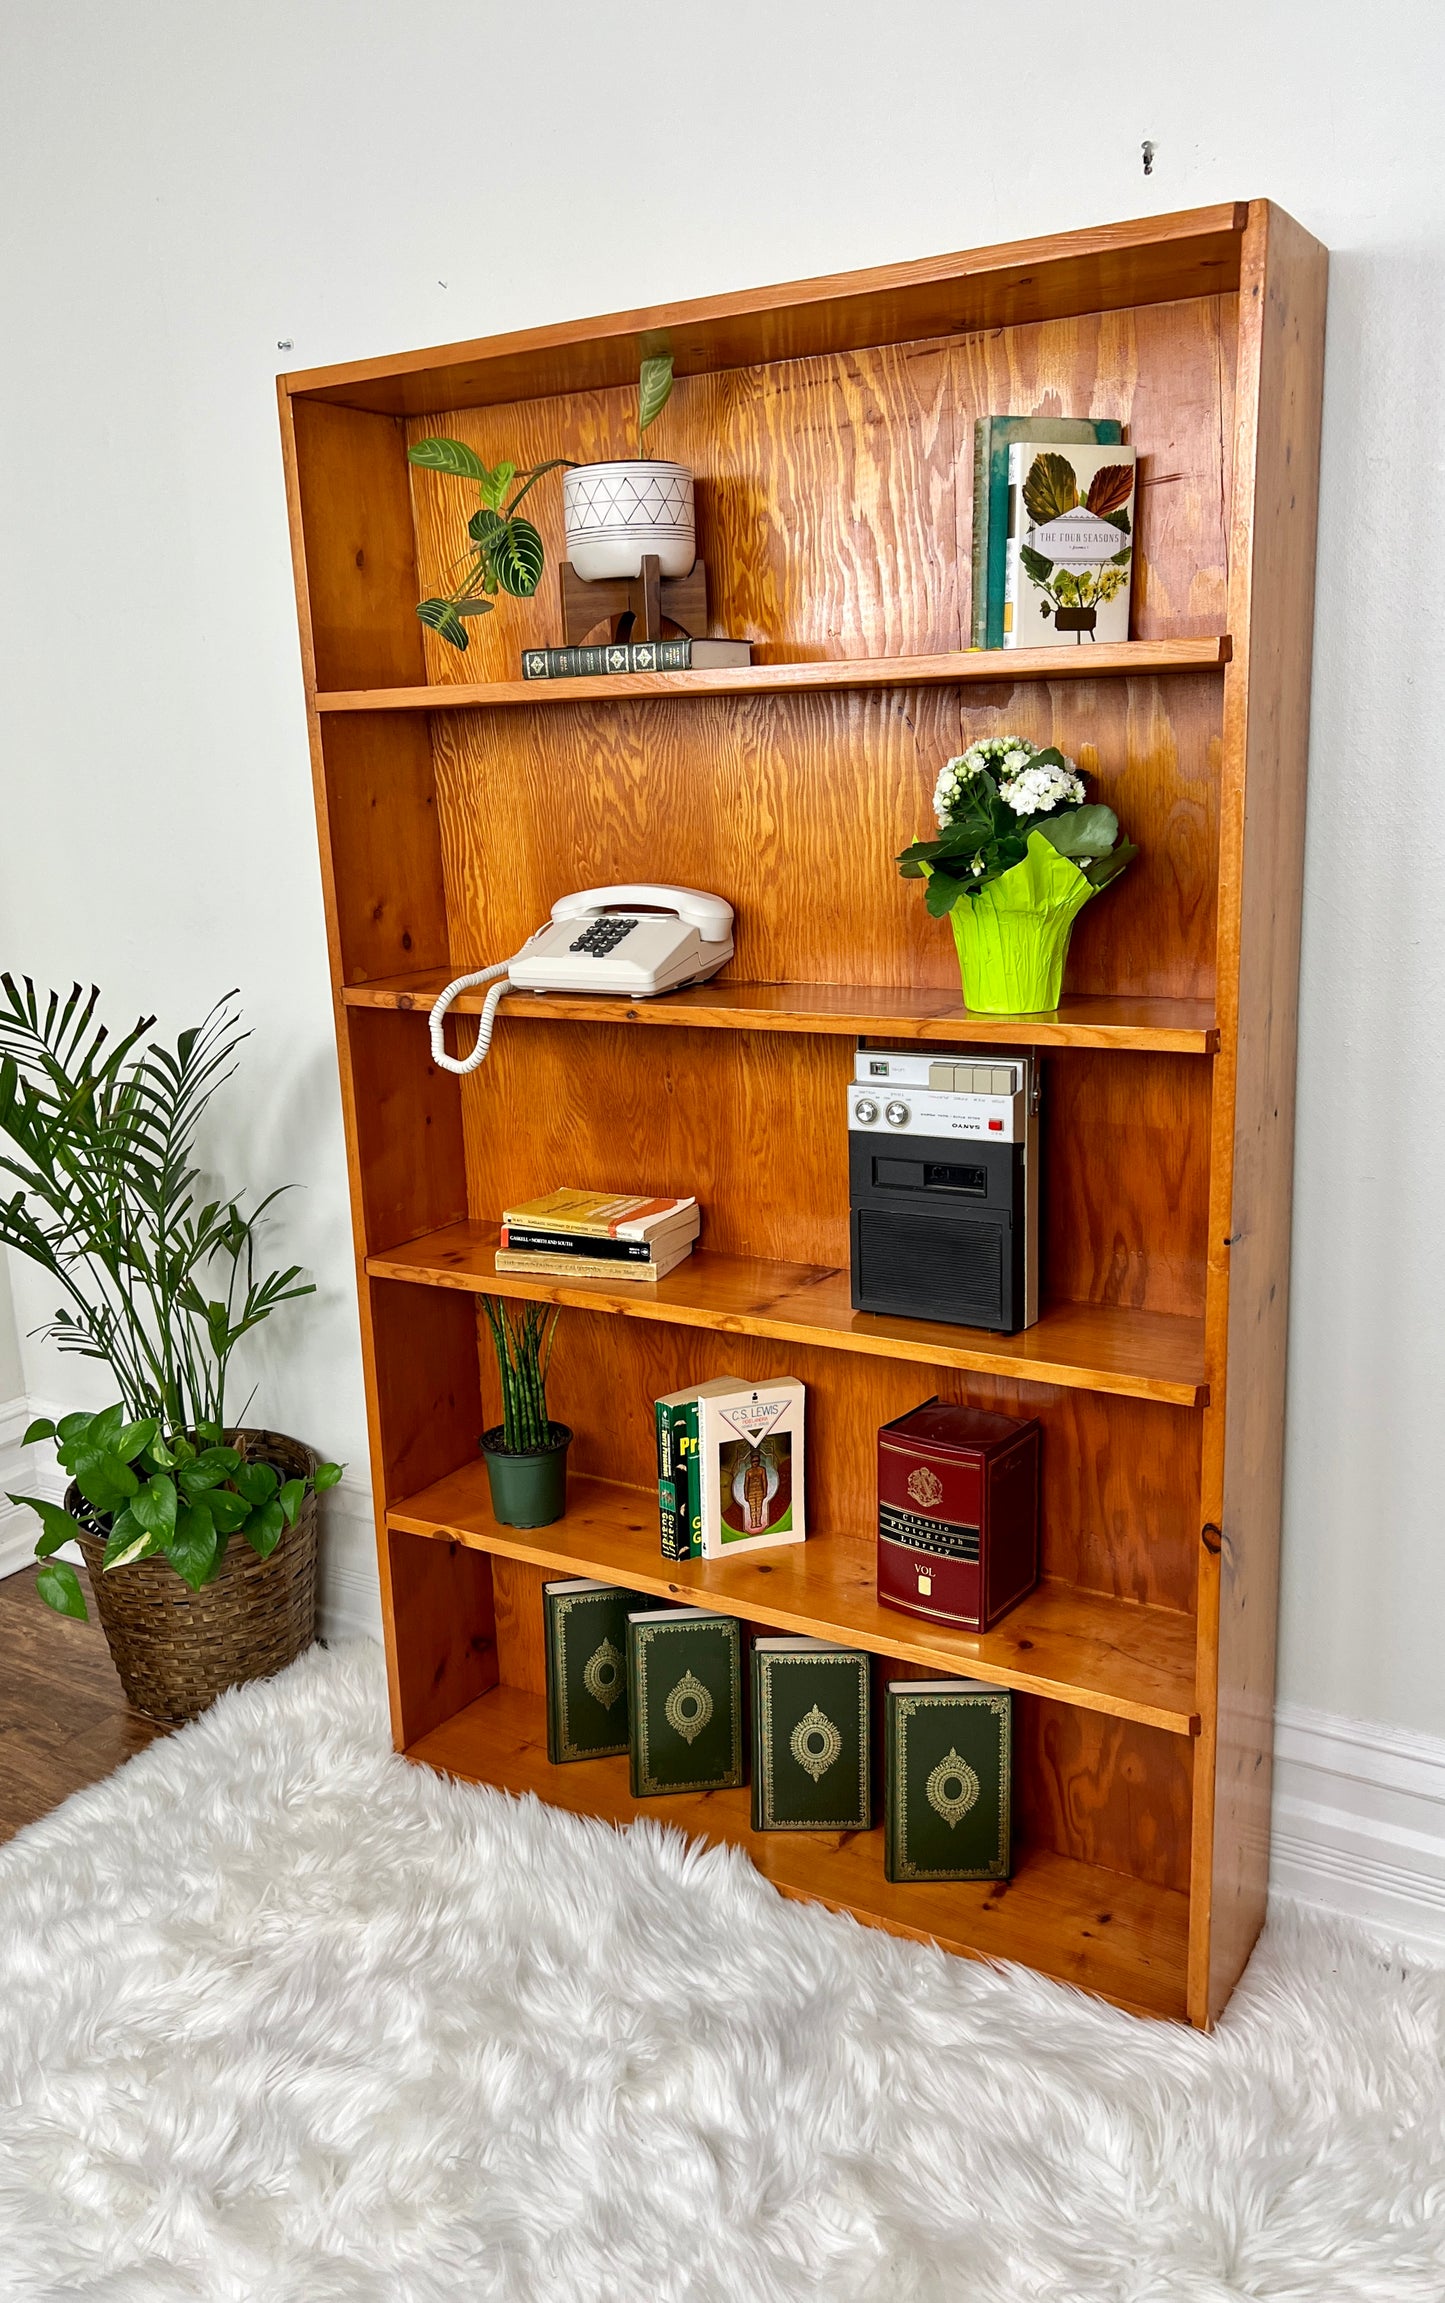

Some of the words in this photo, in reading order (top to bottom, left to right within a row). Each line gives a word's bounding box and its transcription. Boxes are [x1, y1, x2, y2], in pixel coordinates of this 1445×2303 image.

[1040, 532, 1056, 542] THE
[1059, 532, 1081, 542] FOUR
[1083, 533, 1119, 543] SEASONS
[751, 1404, 779, 1418] LEWIS
[902, 1514, 949, 1531] Classic
[891, 1520, 963, 1545] Photograph
[901, 1535, 950, 1555] Library
[914, 1563, 936, 1577] VOL
